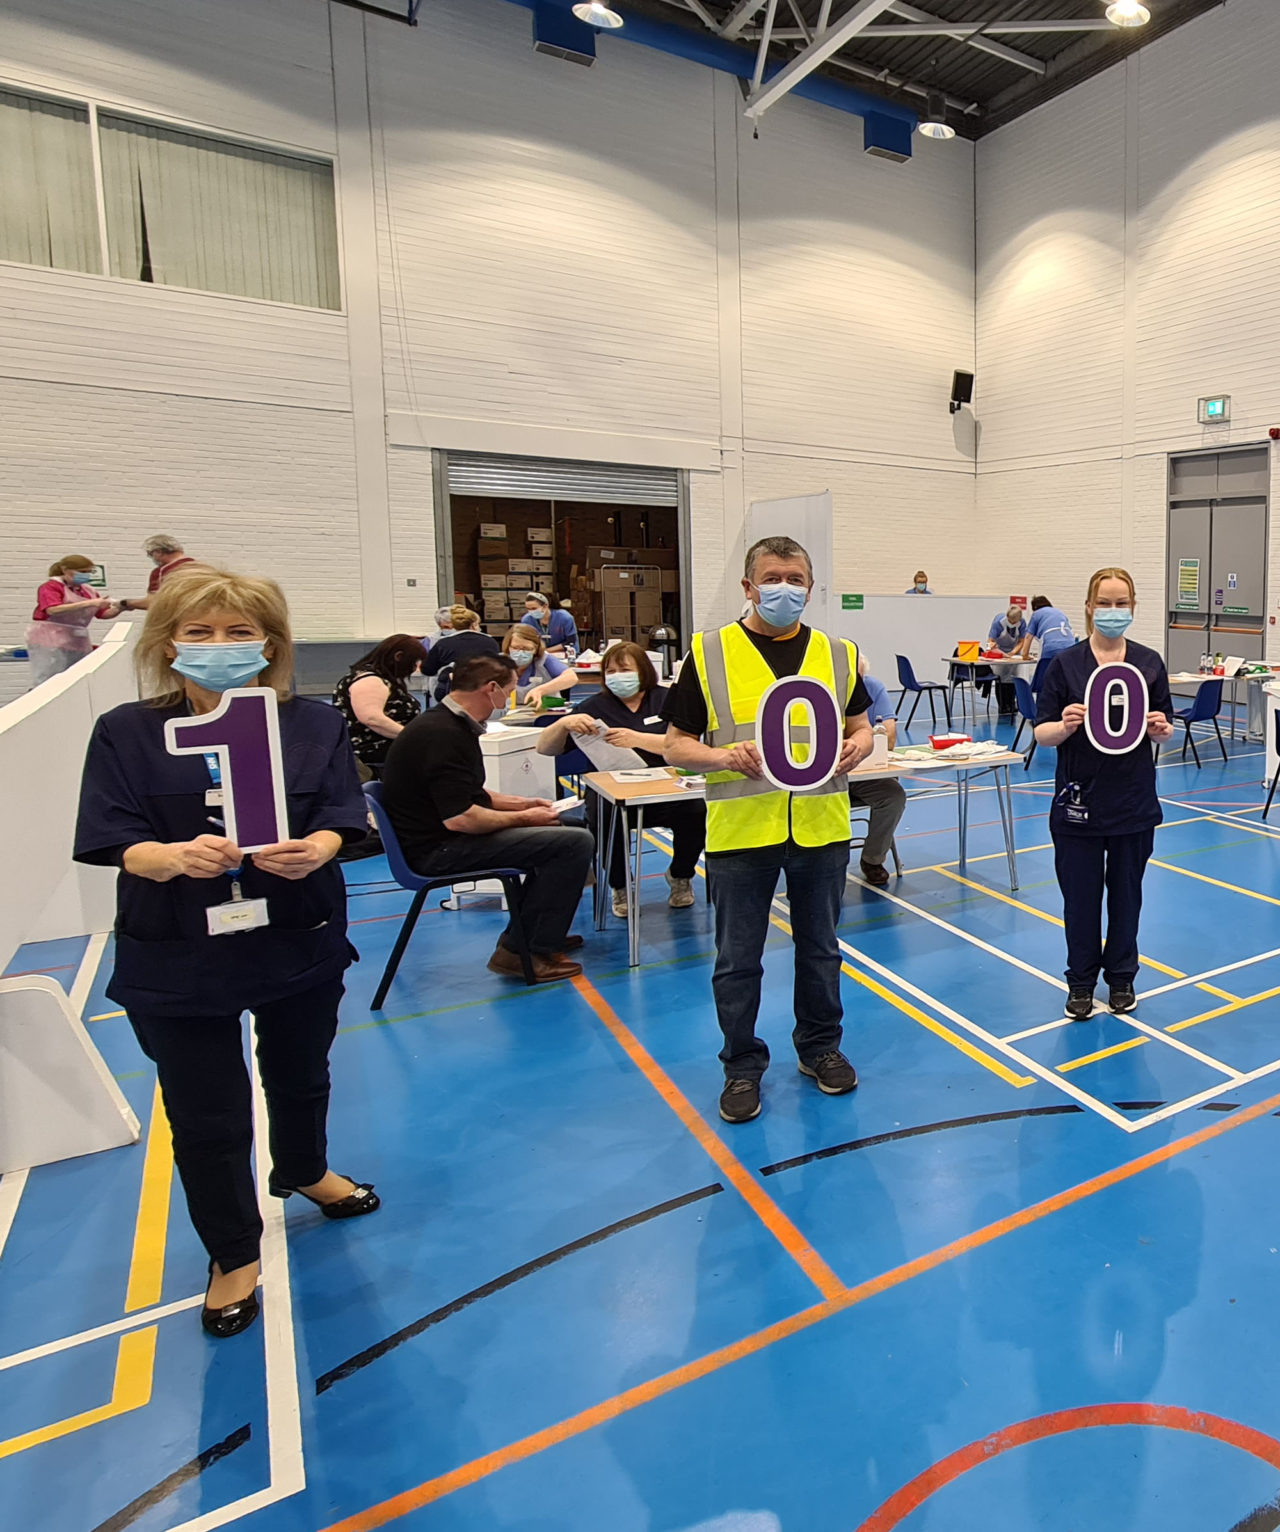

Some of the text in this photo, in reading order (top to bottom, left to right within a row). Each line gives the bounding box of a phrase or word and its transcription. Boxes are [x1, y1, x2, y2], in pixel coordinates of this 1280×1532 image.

[761, 680, 839, 787] 0
[1091, 665, 1145, 750] 0
[172, 694, 281, 849] 1
